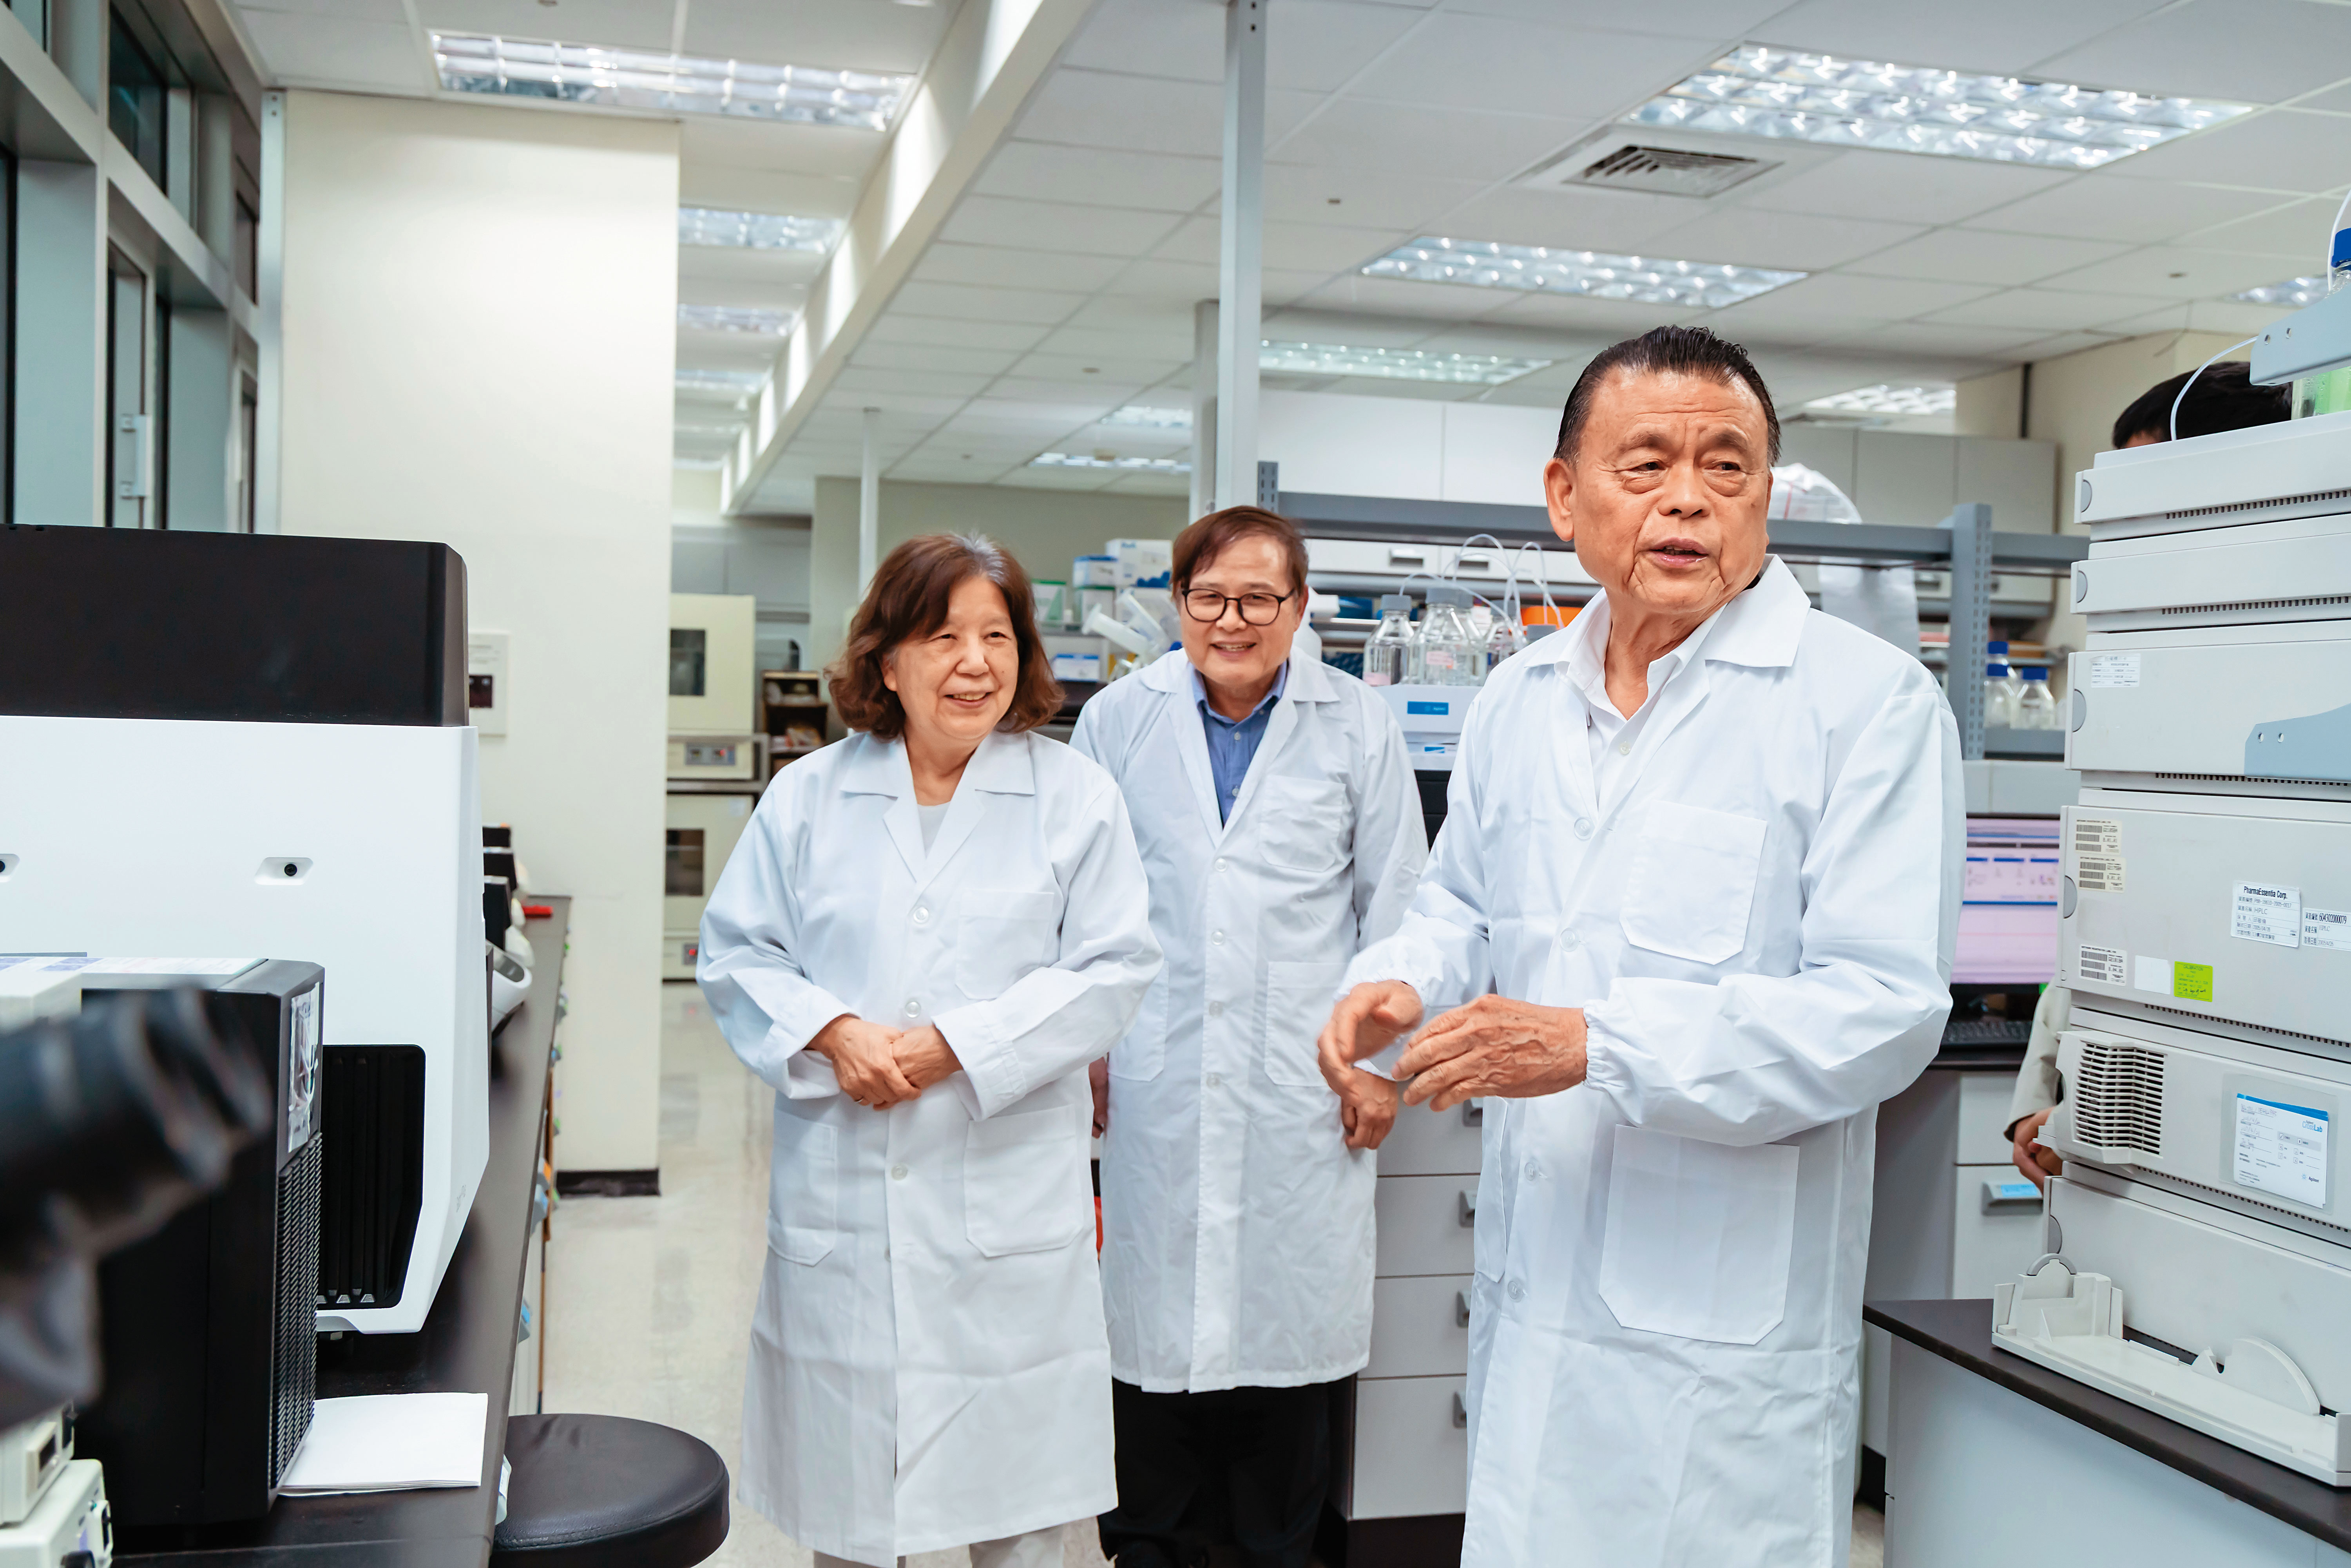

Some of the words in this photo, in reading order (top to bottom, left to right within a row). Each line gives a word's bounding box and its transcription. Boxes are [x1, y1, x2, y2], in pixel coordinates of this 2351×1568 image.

[2244, 886, 2275, 897] PharmaEssentia
[2277, 891, 2288, 900] Corp.
[2319, 913, 2347, 924] 604302000079
[2305, 925, 2317, 934] 資產名稱
[2302, 1121, 2322, 1132] CrossLab
